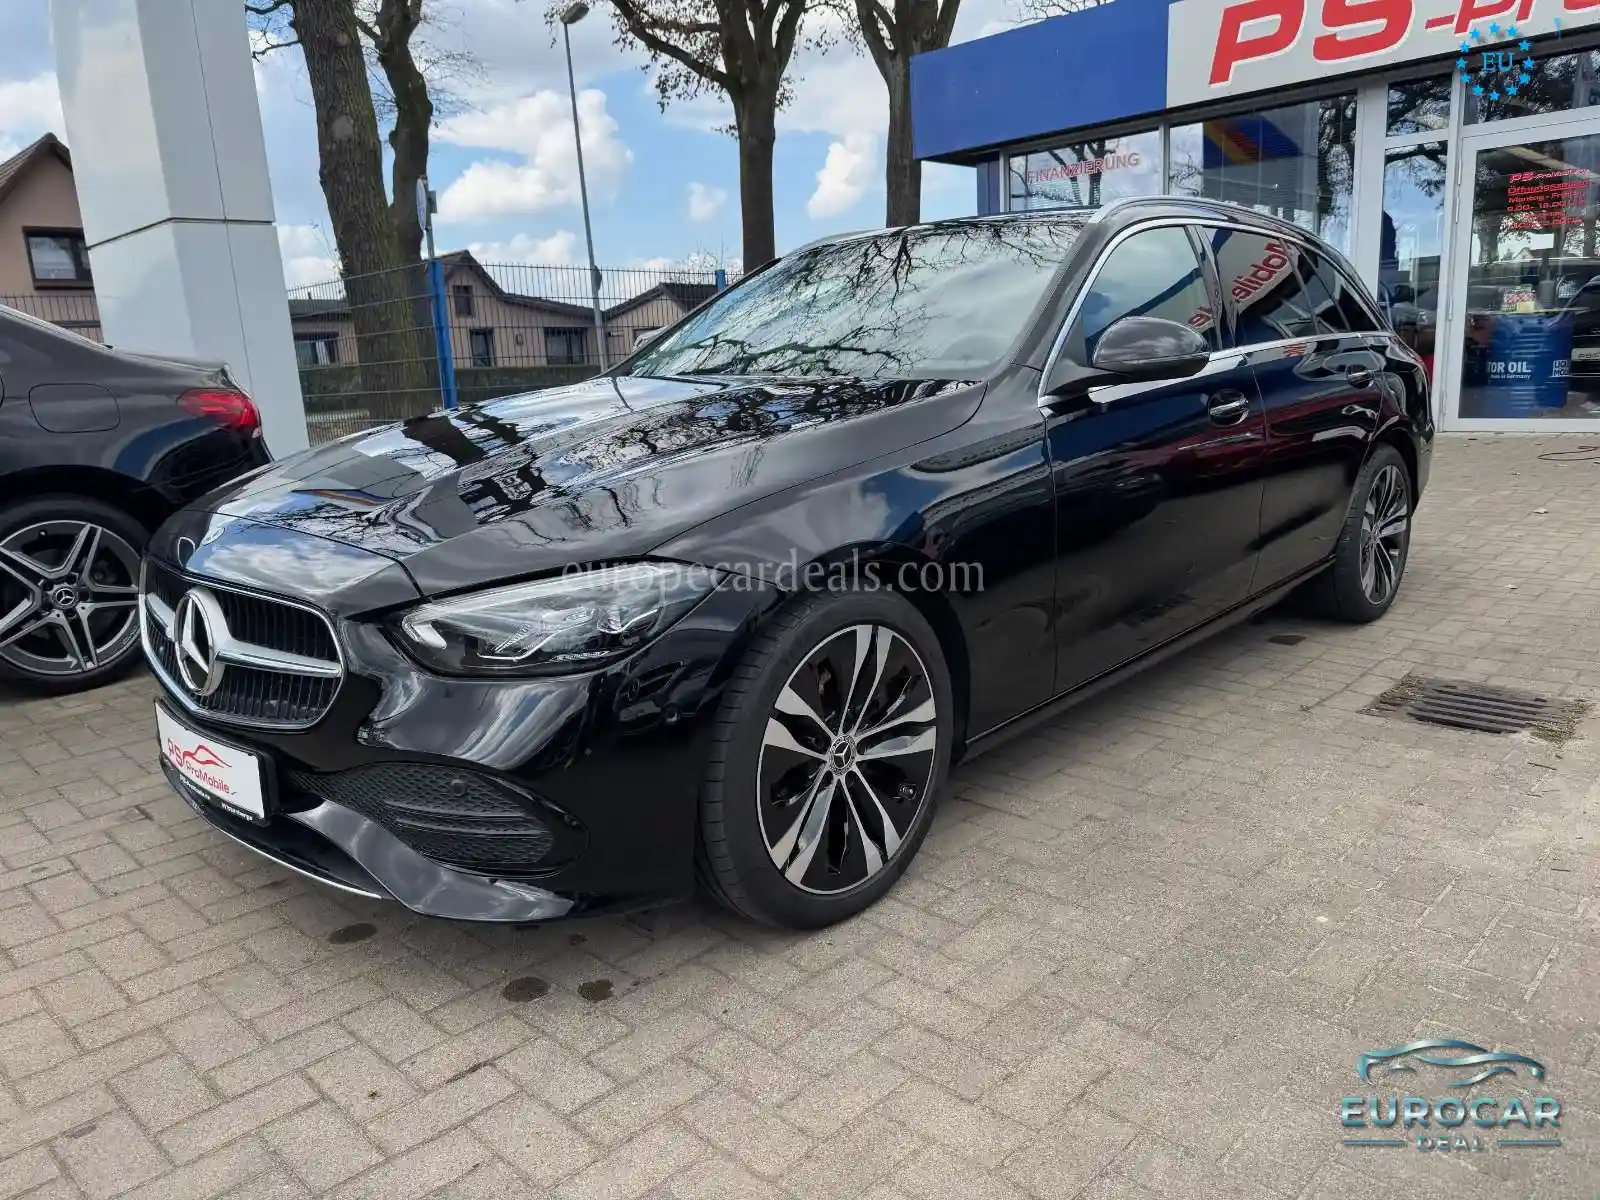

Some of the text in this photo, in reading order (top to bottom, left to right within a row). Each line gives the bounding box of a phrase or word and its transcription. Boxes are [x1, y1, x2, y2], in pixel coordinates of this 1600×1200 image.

[1026, 152, 1140, 184] FINANZIERUNG
[1508, 361, 1532, 373] OIL
[186, 761, 230, 794] ProMobile
